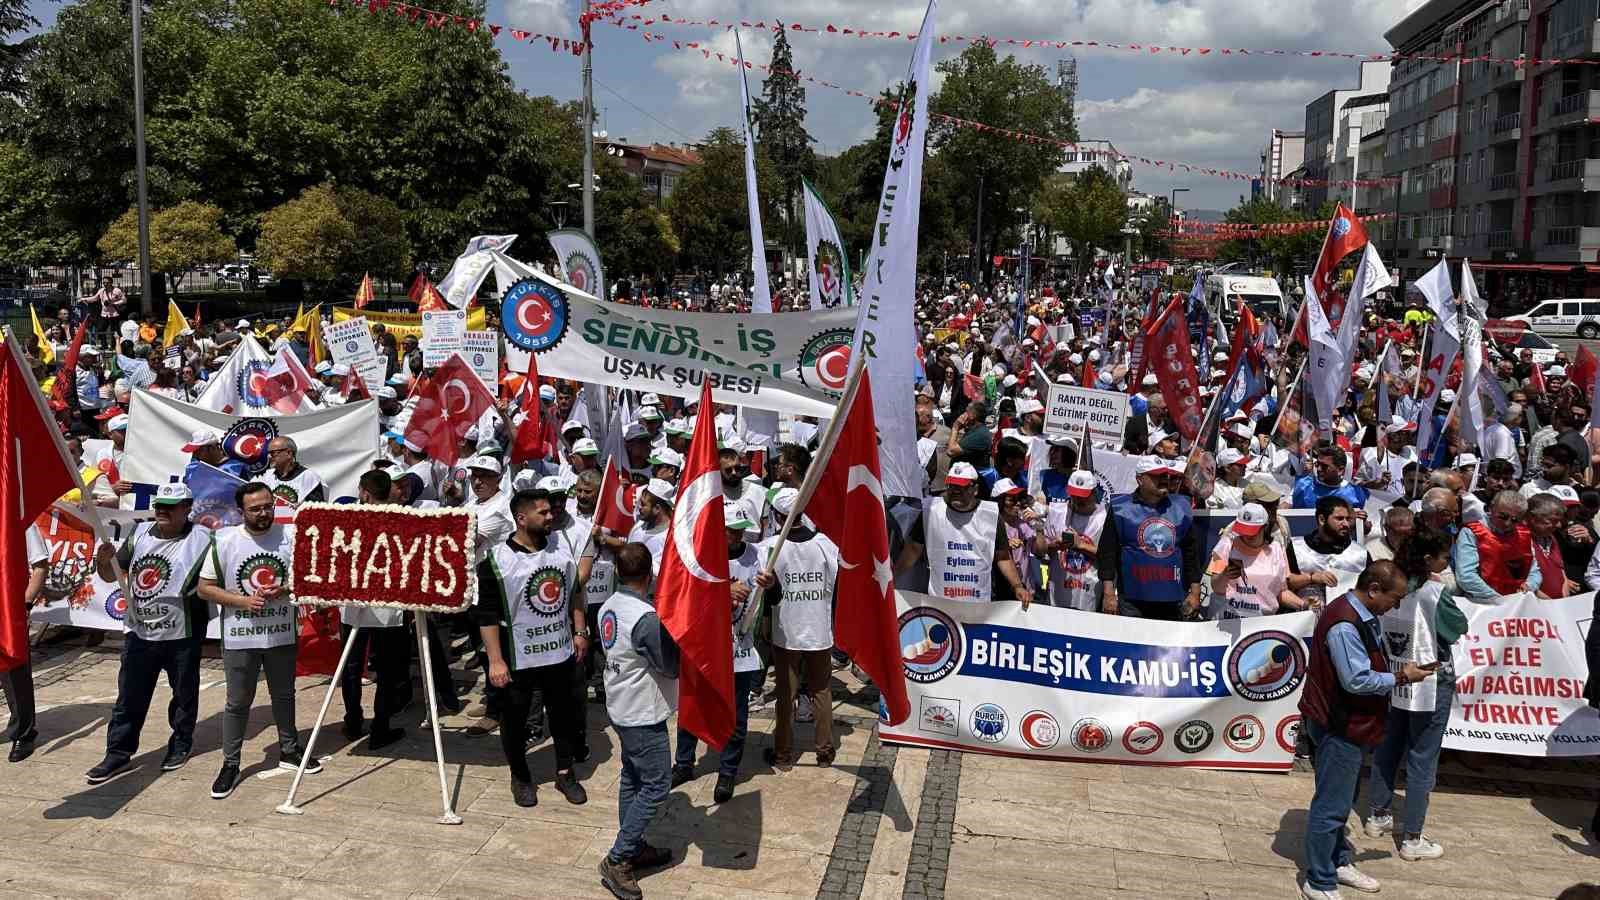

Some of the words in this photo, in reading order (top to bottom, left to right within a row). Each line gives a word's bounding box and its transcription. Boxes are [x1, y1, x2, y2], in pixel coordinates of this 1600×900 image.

[515, 333, 550, 346] 1952
[737, 322, 776, 357] İŞ
[603, 356, 667, 380] UŞAK
[673, 367, 762, 395] ŞUBESİ
[1058, 394, 1086, 406] RANTA
[1089, 397, 1117, 411] DEĞİL,
[1090, 411, 1119, 426] BÜTÇE
[947, 541, 973, 551] Emek
[304, 525, 322, 583] 1
[329, 526, 459, 597] MAYIS
[947, 557, 975, 567] Eylem
[785, 572, 824, 586] ŞEKER
[230, 624, 292, 637] SENDİKASI
[1488, 618, 1560, 643] GENÇL
[972, 632, 1092, 683] BİRLEŞİK
[1100, 654, 1216, 693] KAMU-İŞ
[1470, 648, 1497, 667] EL
[1503, 647, 1542, 667] ELE
[1462, 699, 1562, 727] TÜRKİYE
[1468, 730, 1492, 740] ADD
[1494, 731, 1548, 745] GENÇLİK
